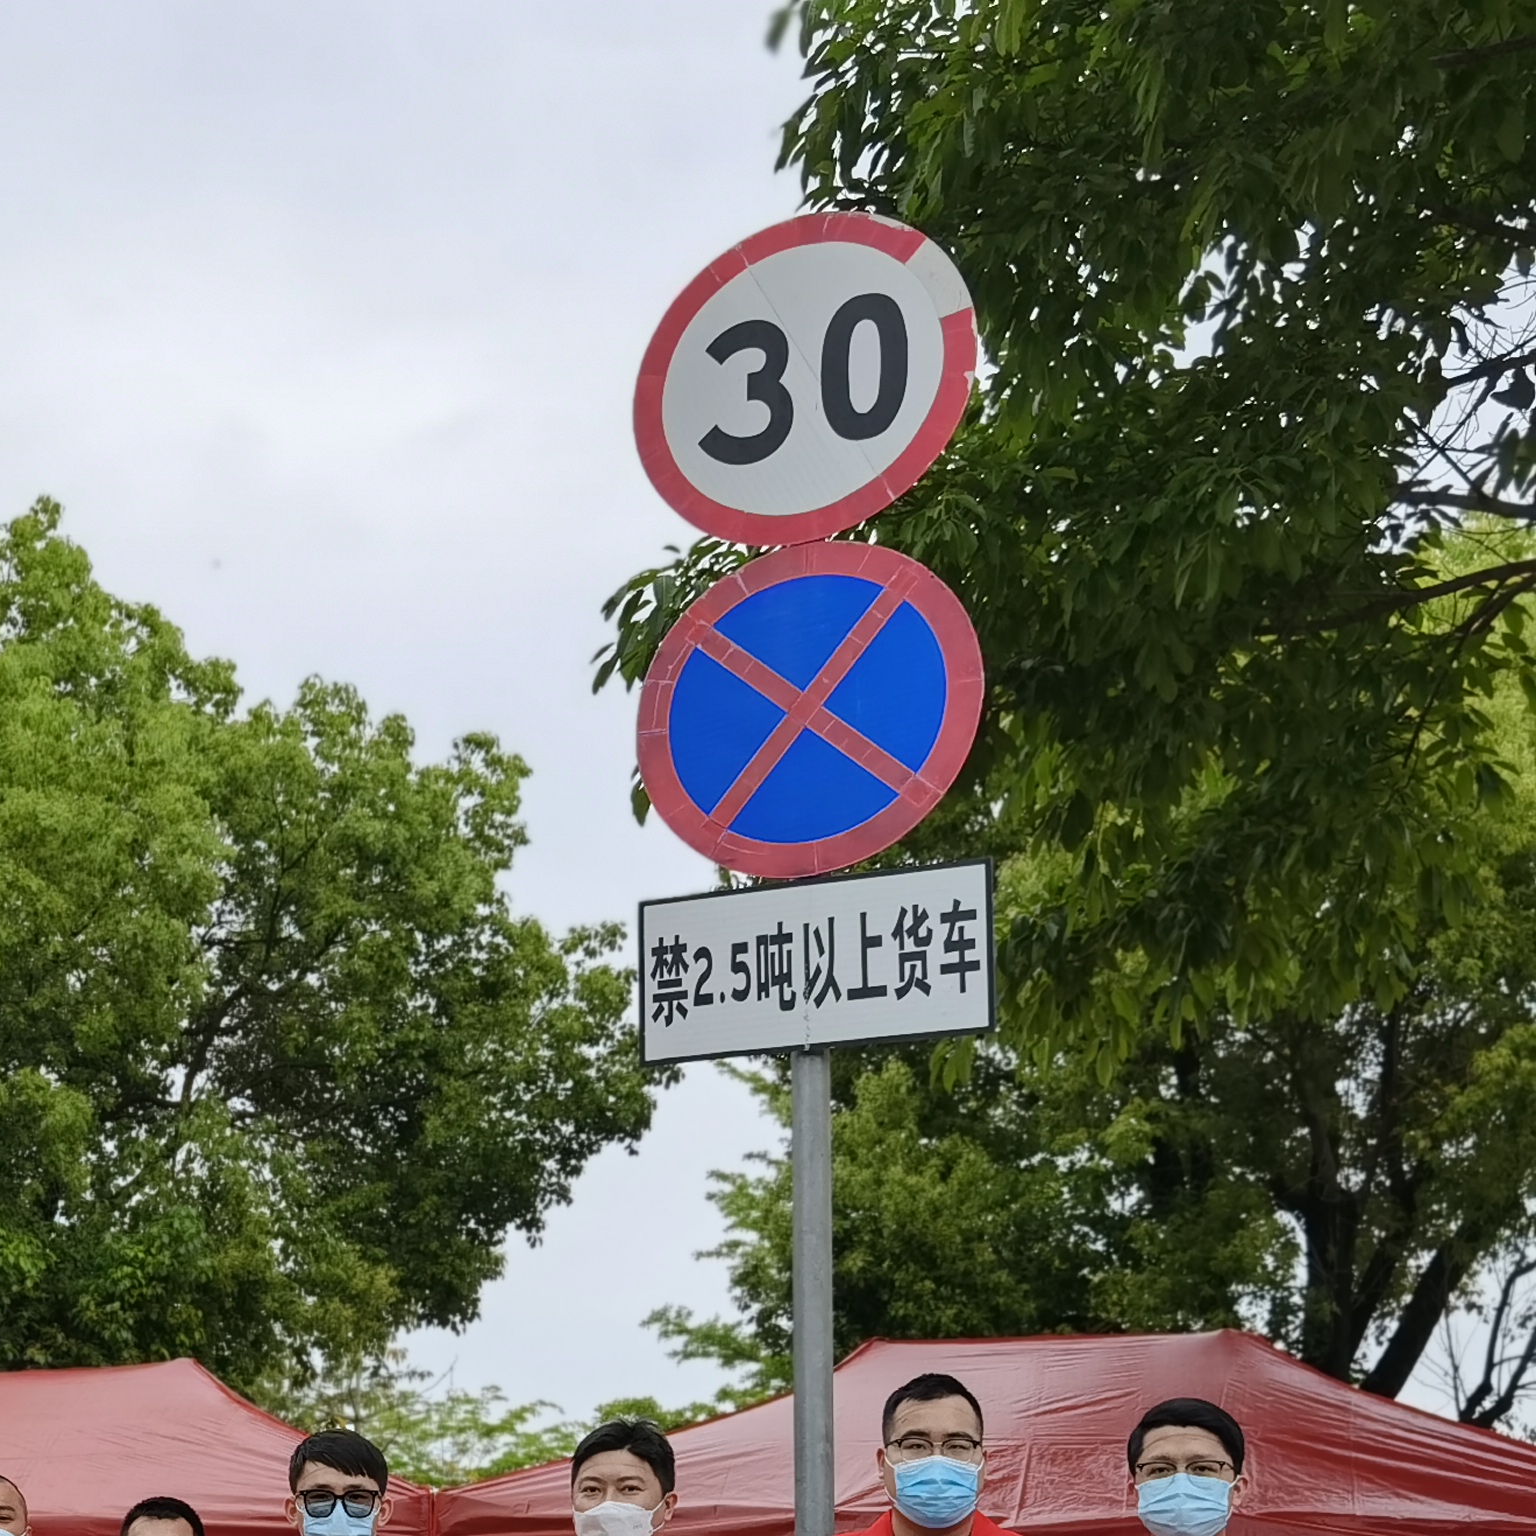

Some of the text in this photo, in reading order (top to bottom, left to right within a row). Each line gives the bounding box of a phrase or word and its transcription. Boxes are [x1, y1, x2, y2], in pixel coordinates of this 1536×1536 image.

[698, 292, 909, 466] 30
[650, 898, 981, 1028] 禁2.5吨以上货车
